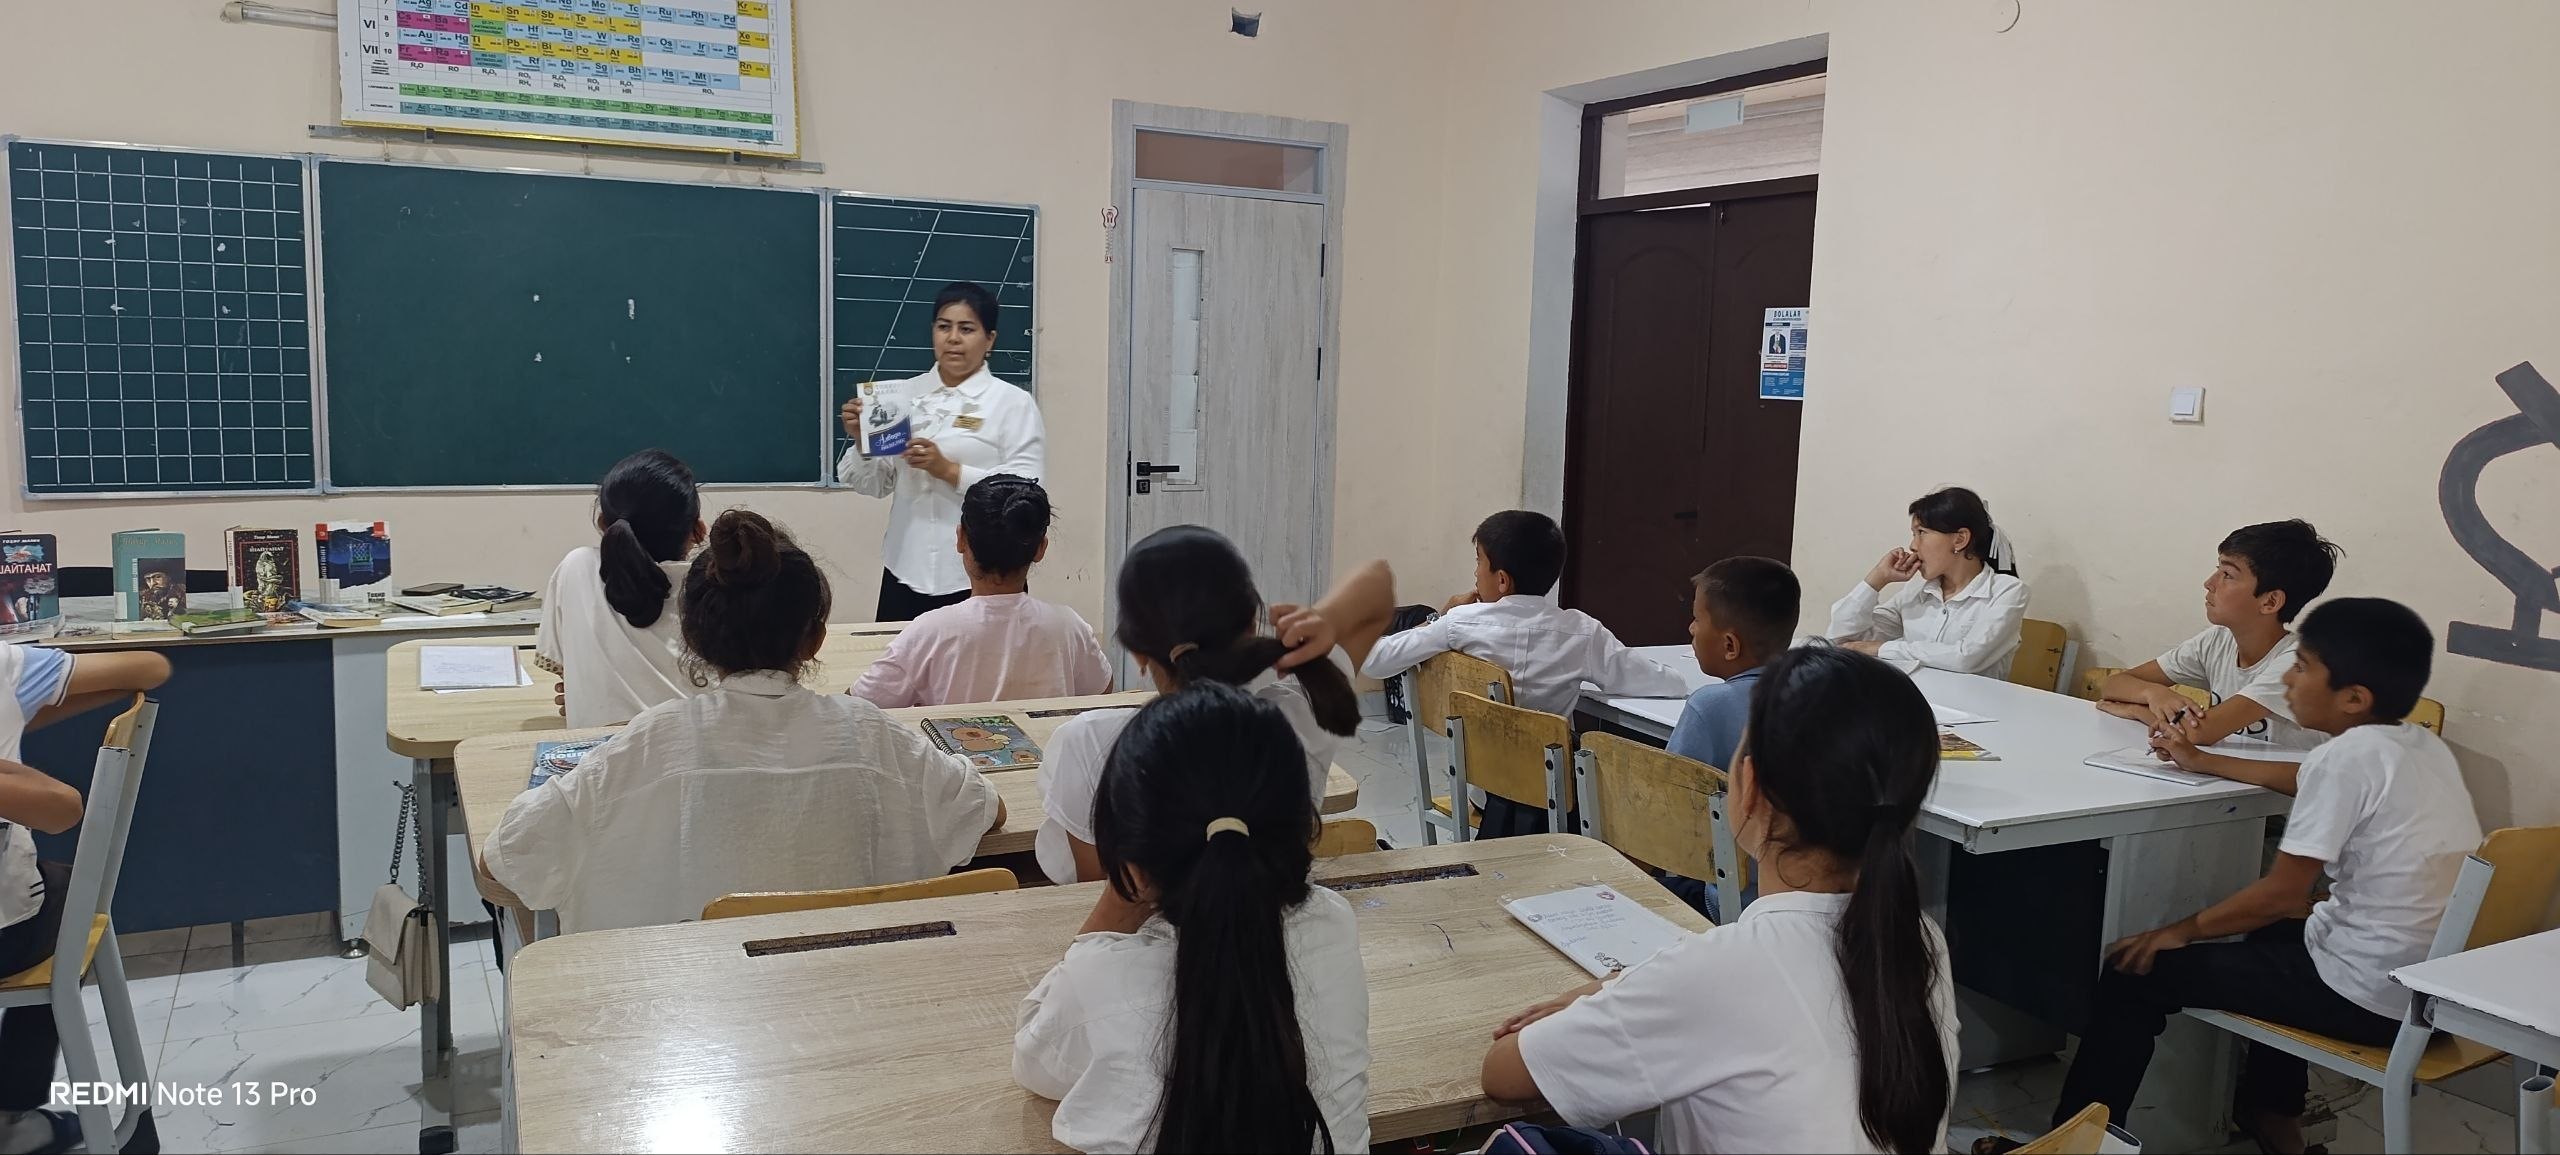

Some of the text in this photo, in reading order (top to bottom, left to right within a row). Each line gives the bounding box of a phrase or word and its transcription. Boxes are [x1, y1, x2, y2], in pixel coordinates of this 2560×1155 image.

[454, 1, 468, 10] Cd
[471, 3, 480, 11] In
[591, 1, 605, 9] Mo
[629, 4, 639, 12] Tc
[737, 1, 747, 9] Kr
[506, 7, 519, 15] Sn
[541, 10, 554, 19] Sb
[659, 7, 672, 15] Ru
[691, 11, 704, 19] Rh
[576, 14, 586, 22] Te
[723, 15, 736, 23] Pd
[363, 19, 376, 30] VI
[527, 25, 539, 33] Hf
[562, 28, 573, 36] Ta
[418, 30, 433, 39] Au
[455, 33, 468, 44] Hg
[597, 32, 606, 40] W
[739, 31, 750, 40] Xe
[506, 39, 520, 47] Pb
[627, 35, 640, 43] Re
[660, 38, 672, 46] Os
[363, 44, 379, 54] VII
[541, 42, 552, 50] Bi
[576, 45, 589, 54] Po
[698, 42, 705, 50] Ir
[727, 45, 736, 54] Pt
[610, 49, 620, 57] At
[528, 57, 540, 65] Rf
[560, 59, 574, 68] Db
[595, 62, 607, 72] Sg
[740, 61, 752, 70] Rn
[628, 66, 641, 74] Bh
[661, 69, 673, 77] Hs
[695, 72, 706, 80] Mt
